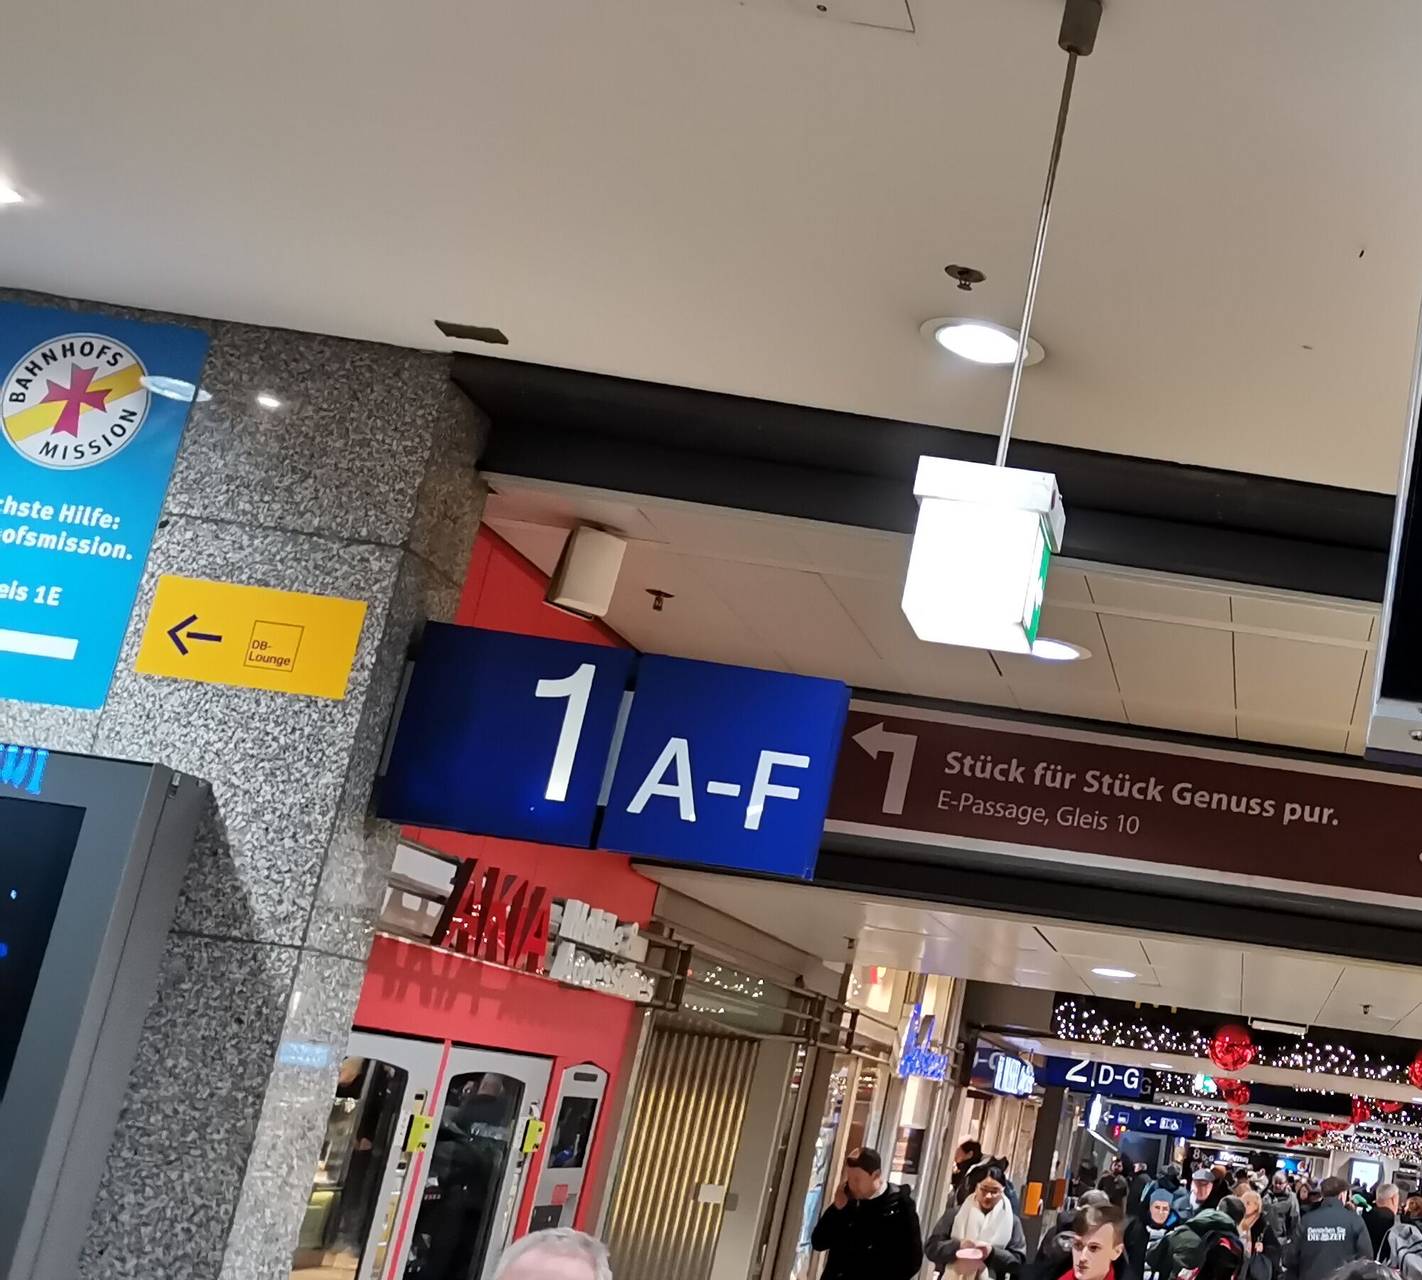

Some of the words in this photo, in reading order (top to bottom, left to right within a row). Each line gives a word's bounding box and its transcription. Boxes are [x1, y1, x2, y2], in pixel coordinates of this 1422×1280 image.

[8, 341, 124, 404] BAHNHOFS
[38, 408, 138, 460] MISSION
[58, 503, 121, 530] Hilfe:
[0, 525, 133, 561] ofsmission.
[33, 585, 64, 607] 1E
[248, 650, 291, 668] Lounge
[251, 639, 272, 651] DB-
[534, 662, 597, 802] 1
[625, 736, 811, 830] A-F
[943, 750, 1026, 784] Stück
[1033, 761, 1077, 791] für
[1082, 769, 1165, 803] Stück
[1171, 782, 1276, 818] Genuss
[1282, 799, 1341, 827] pur.
[936, 790, 1051, 828] E-Passage,
[1056, 805, 1109, 832] Gleis
[1117, 813, 1141, 835] 10
[1098, 1064, 1140, 1090] D-G
